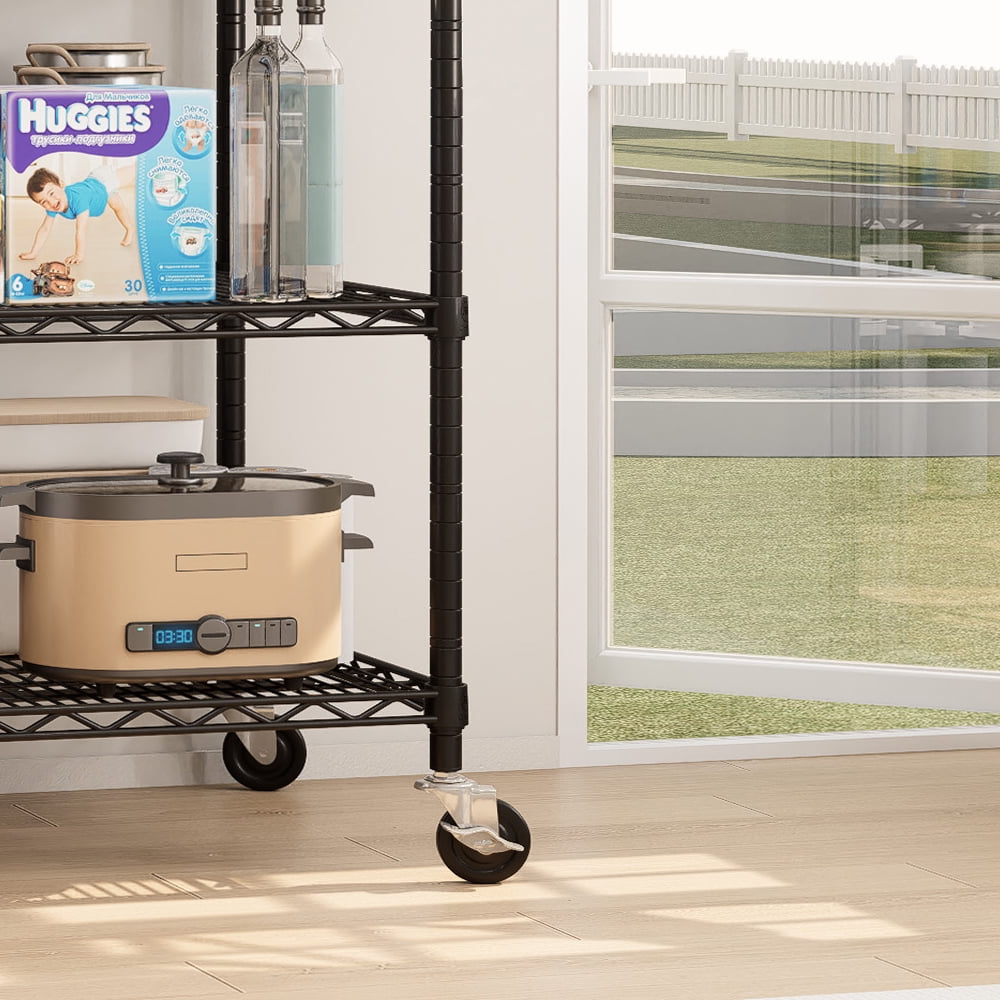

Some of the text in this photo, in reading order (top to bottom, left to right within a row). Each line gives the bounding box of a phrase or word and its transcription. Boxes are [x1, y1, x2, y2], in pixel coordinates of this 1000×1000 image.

[18, 98, 151, 133] HUGGIES
[12, 275, 23, 291] 6
[124, 279, 142, 292] 30
[155, 629, 193, 644] 03:30
